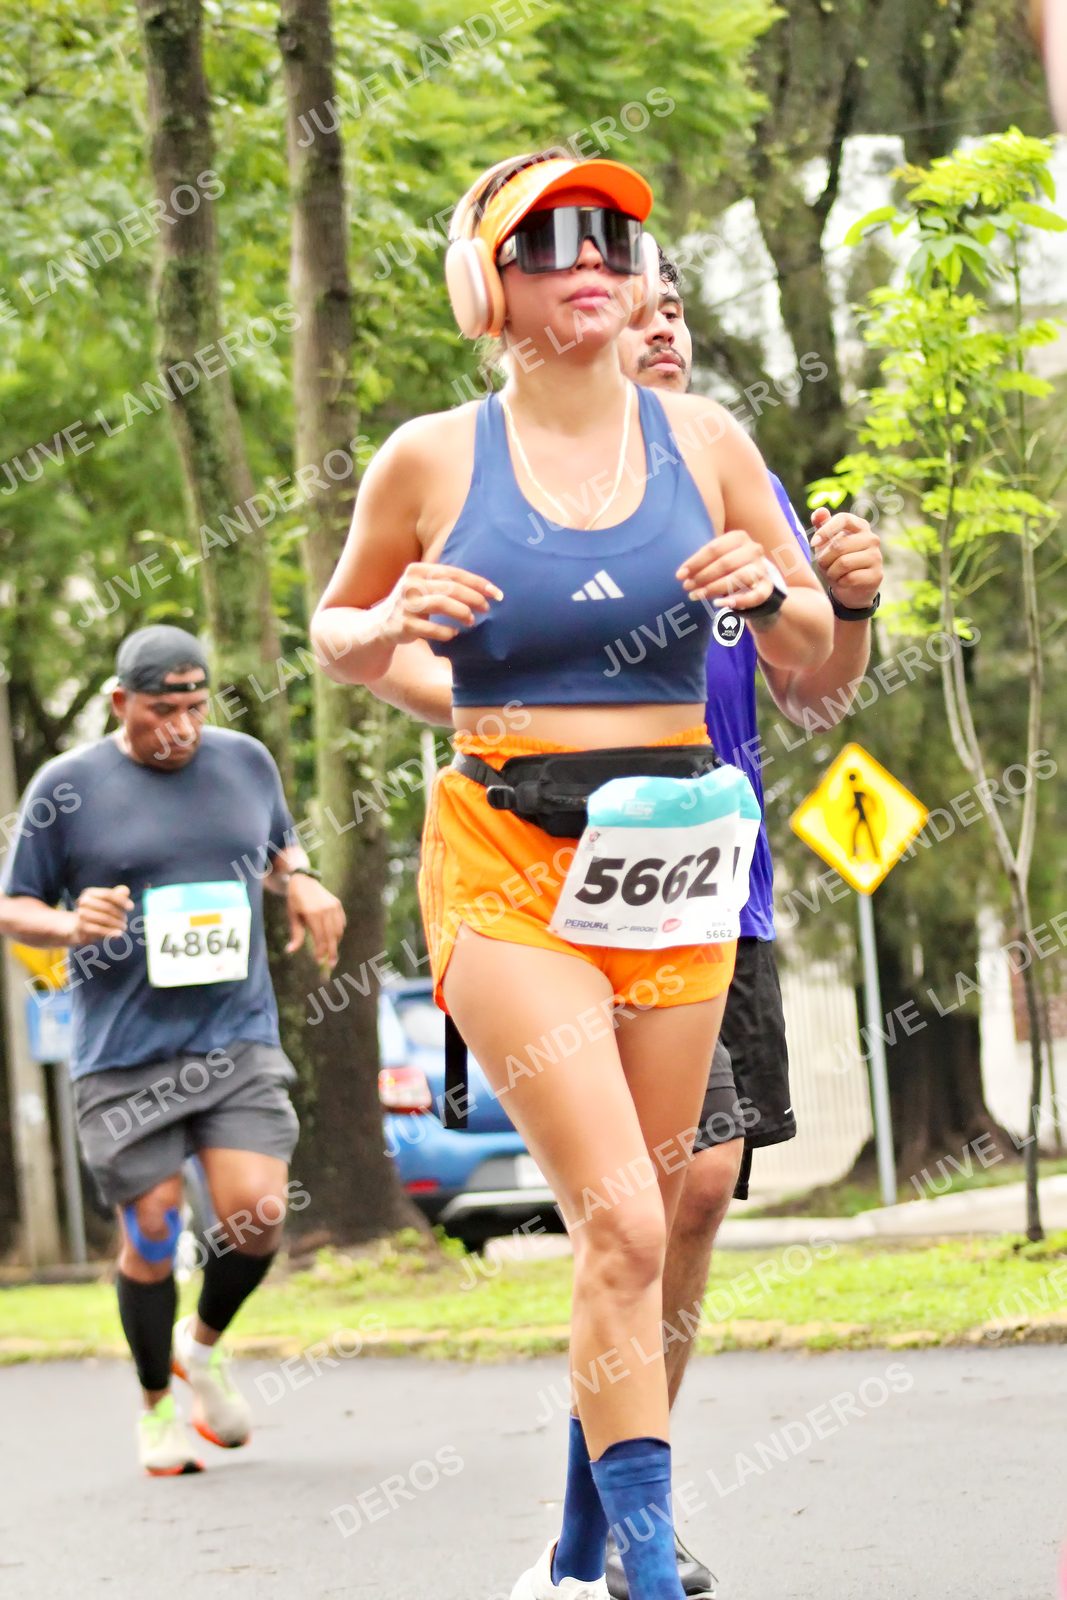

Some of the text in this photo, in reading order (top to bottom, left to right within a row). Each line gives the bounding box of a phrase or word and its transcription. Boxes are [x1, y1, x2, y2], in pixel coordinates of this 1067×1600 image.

[575, 847, 720, 906] 5662
[564, 919, 609, 930] PERDURA
[706, 929, 733, 939] 5662
[160, 928, 241, 958] 4864
